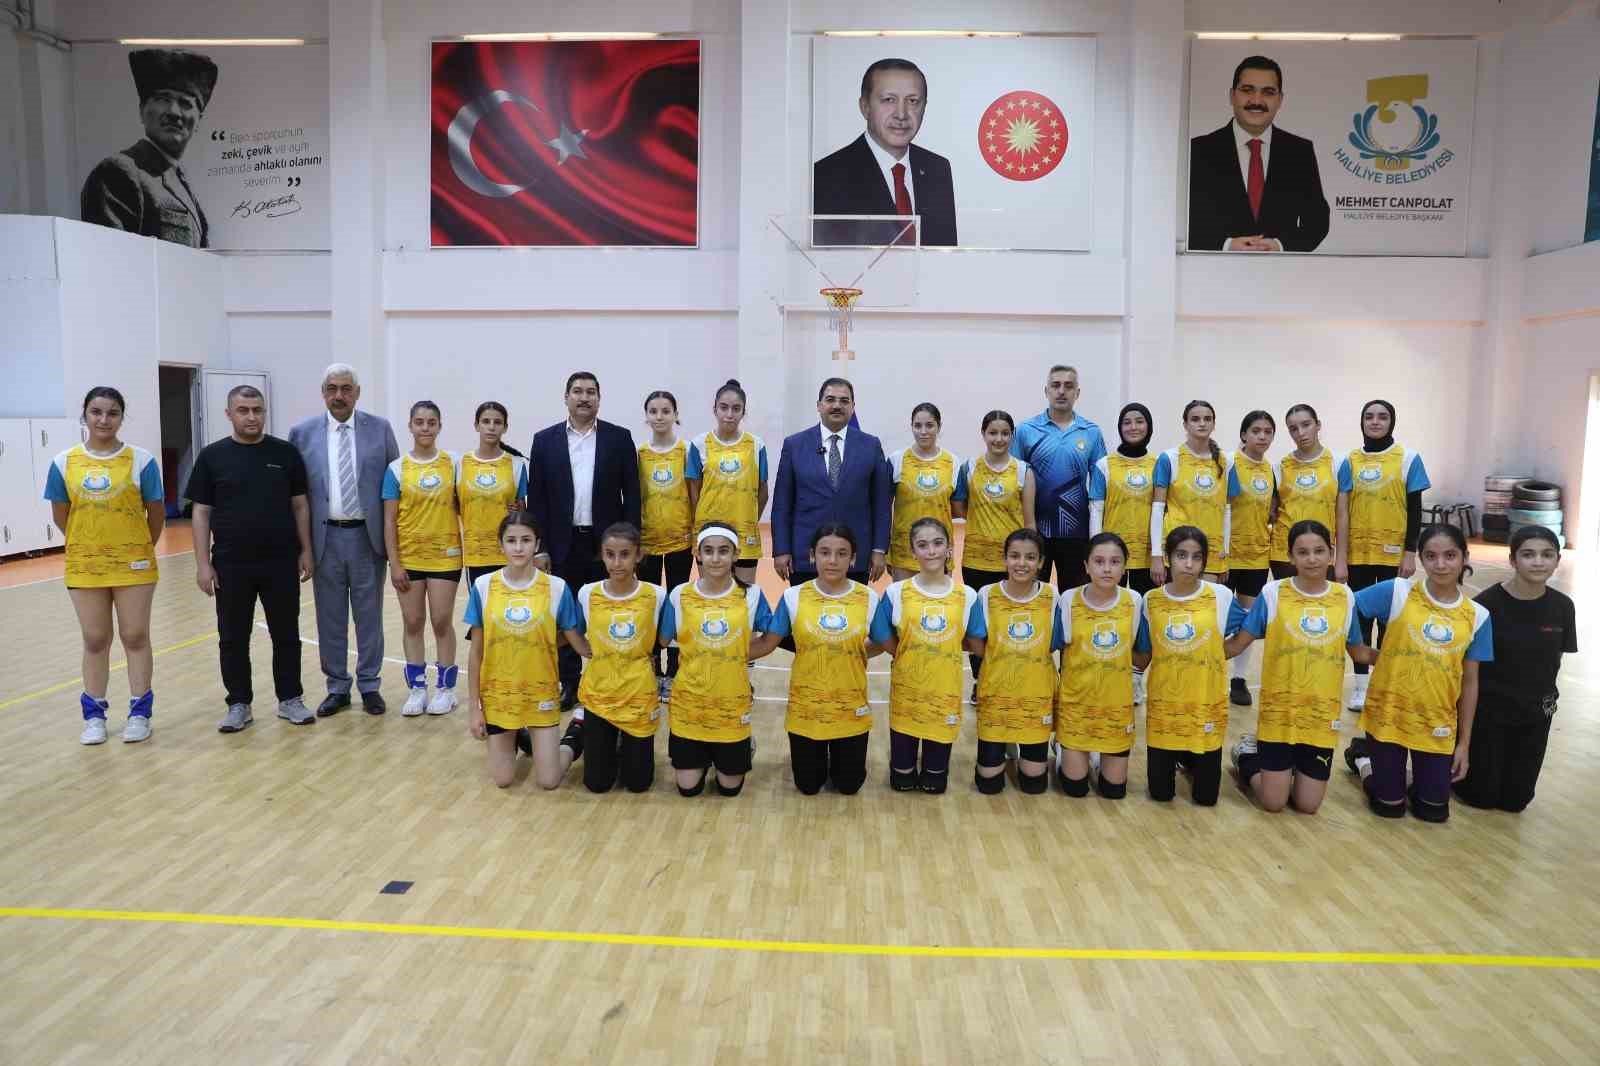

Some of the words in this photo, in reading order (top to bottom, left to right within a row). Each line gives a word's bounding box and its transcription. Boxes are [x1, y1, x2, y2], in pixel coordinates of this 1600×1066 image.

[221, 148, 244, 160] zeki,
[246, 144, 273, 160] çevik
[254, 158, 287, 172] ahlaklı
[1335, 196, 1388, 208] MEHMET
[1389, 197, 1454, 209] CANPOLAT
